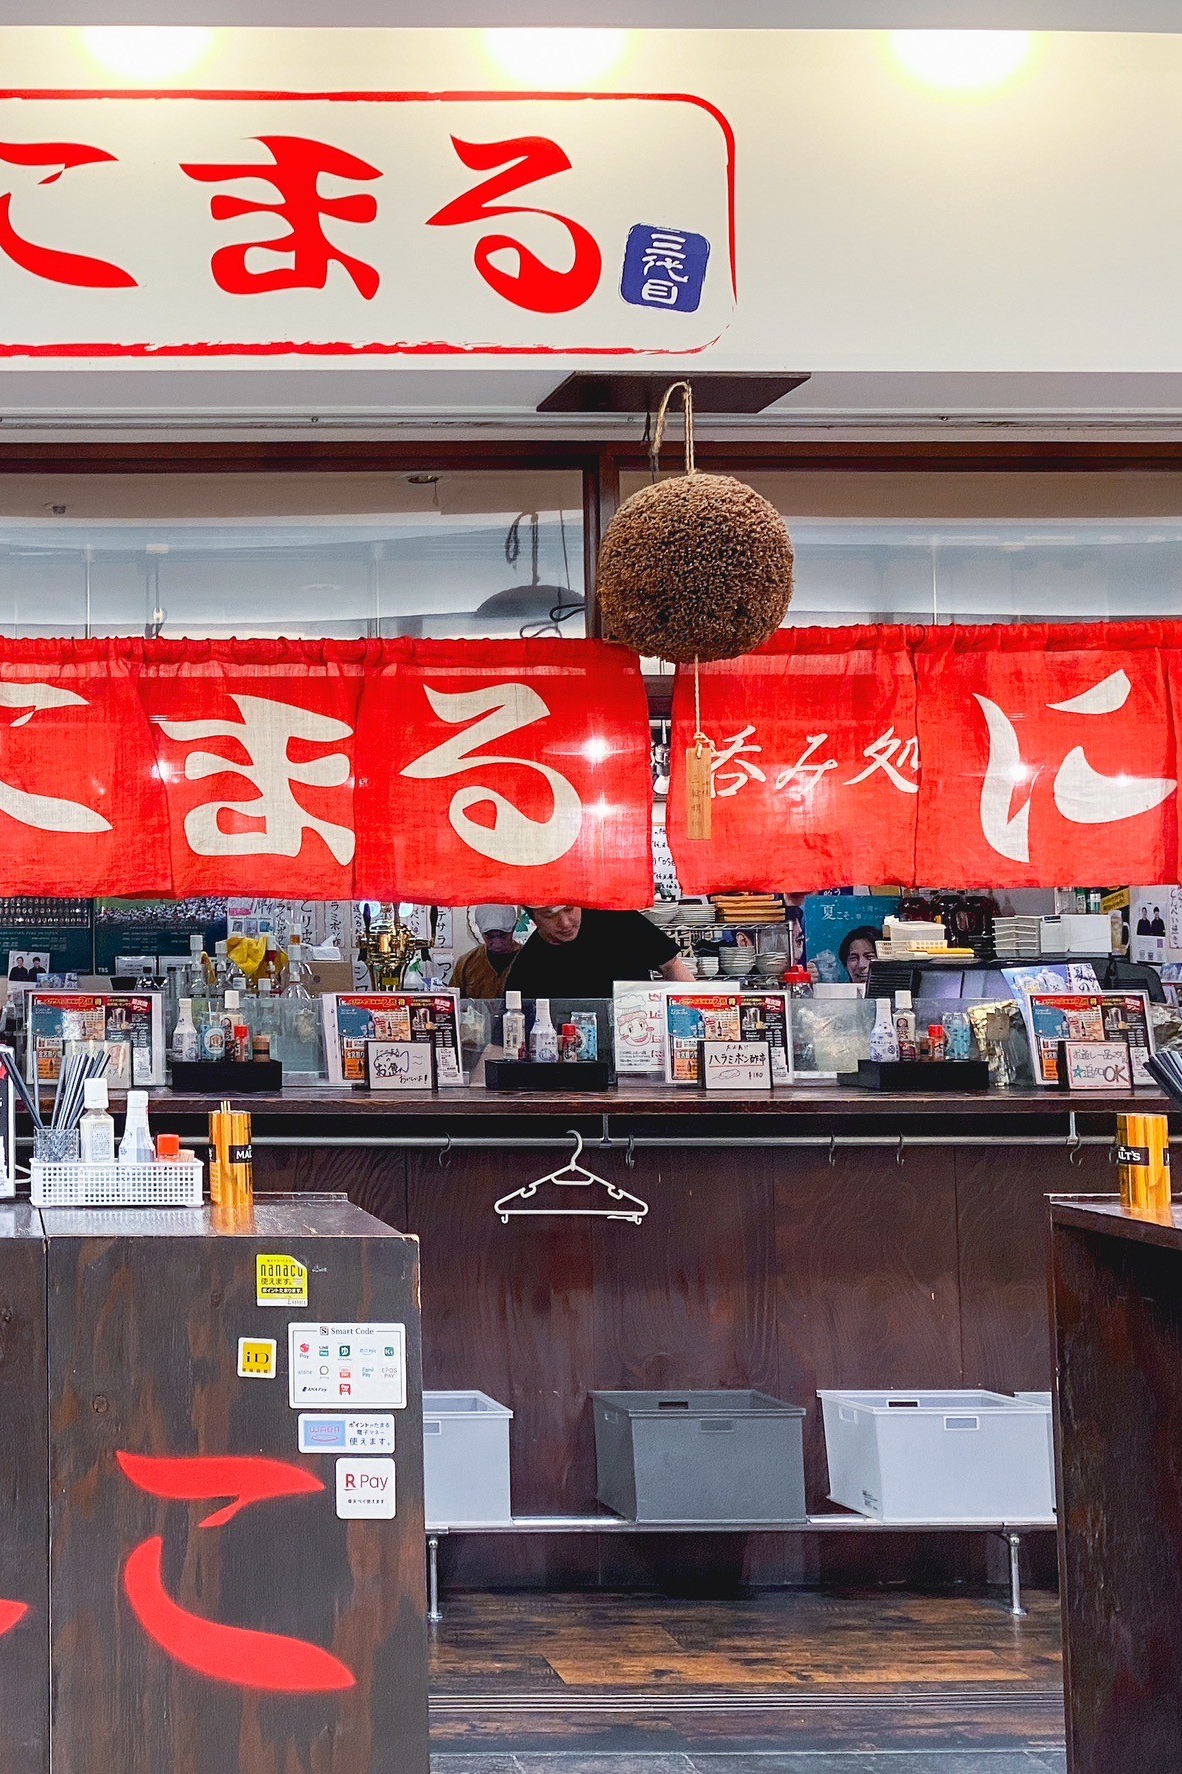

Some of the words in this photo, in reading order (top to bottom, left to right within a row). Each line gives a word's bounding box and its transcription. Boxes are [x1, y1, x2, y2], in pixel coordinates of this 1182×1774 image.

[641, 233, 690, 305] 三代目
[710, 724, 921, 799] 呑み処
[972, 668, 1178, 863] に
[261, 1277, 292, 1286] 使えます。
[349, 1437, 391, 1446] 使えます。
[360, 1474, 389, 1491] Pay
